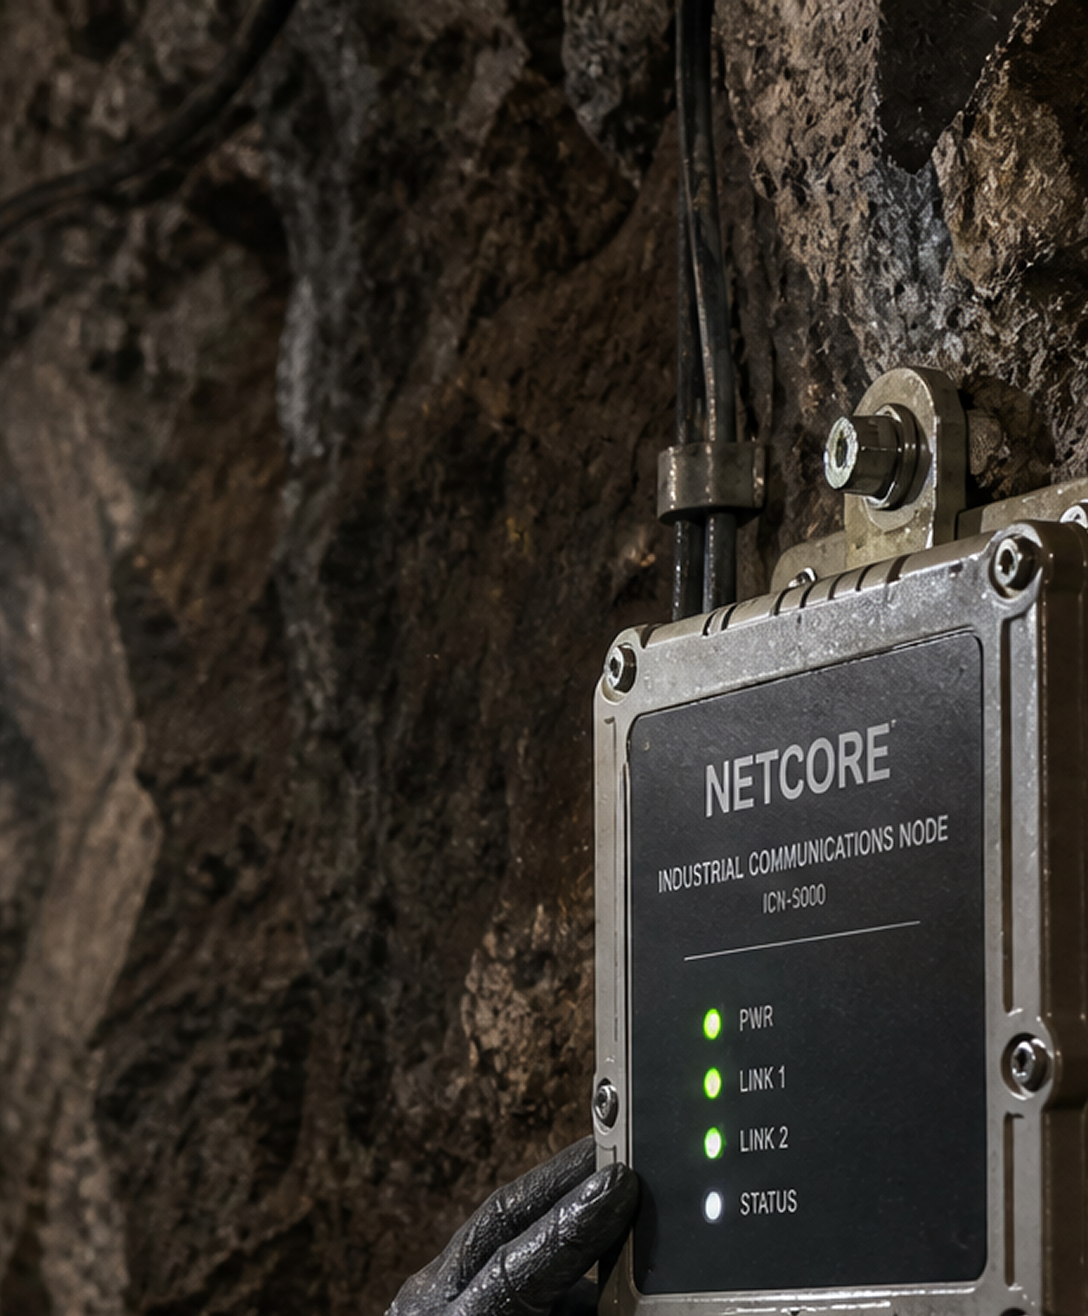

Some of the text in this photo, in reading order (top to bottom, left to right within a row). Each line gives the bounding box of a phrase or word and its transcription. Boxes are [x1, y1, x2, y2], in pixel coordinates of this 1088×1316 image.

[706, 723, 891, 817] NETCORE
[658, 815, 948, 893] INDUSTRIAL COMMUNICATIONS NODE
[739, 1005, 774, 1031] PWR
[739, 1065, 785, 1093] LINK 1
[739, 1126, 789, 1152] LINK 2
[740, 1189, 798, 1216] STATUS
